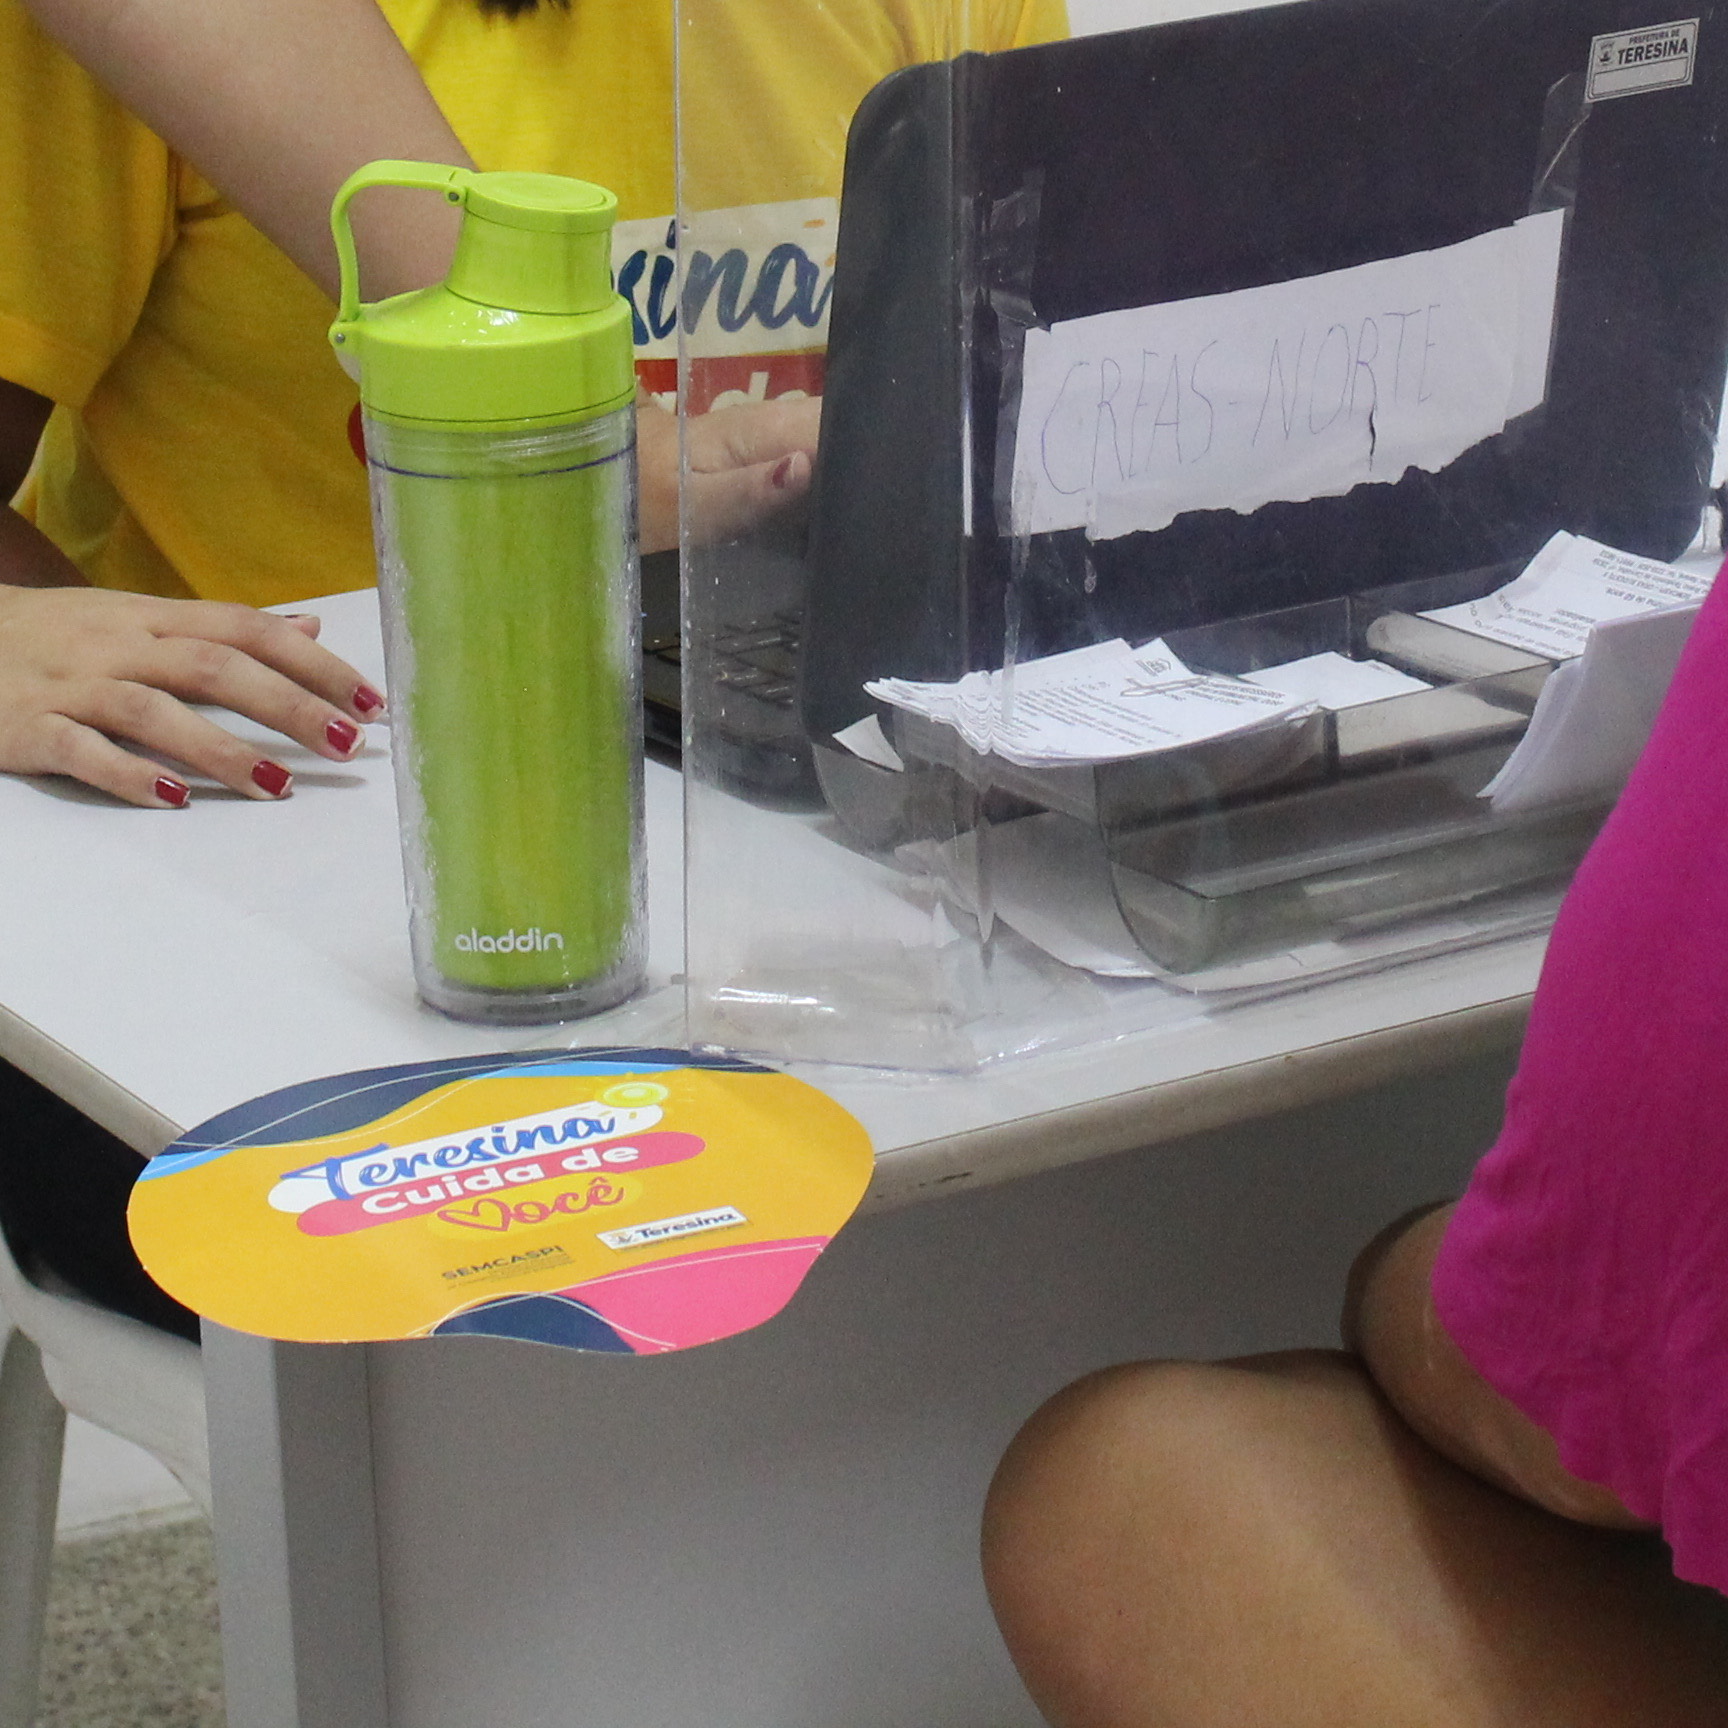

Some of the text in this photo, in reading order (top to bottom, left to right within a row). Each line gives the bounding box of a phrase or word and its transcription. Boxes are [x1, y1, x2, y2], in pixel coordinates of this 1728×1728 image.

[1617, 38, 1689, 65] TERESINA
[454, 927, 565, 954] aladdin
[280, 1114, 616, 1202] Teresina
[361, 1145, 641, 1215] Cuida de
[634, 1211, 739, 1241] Teresina
[441, 1244, 566, 1281] SEMCASPI
